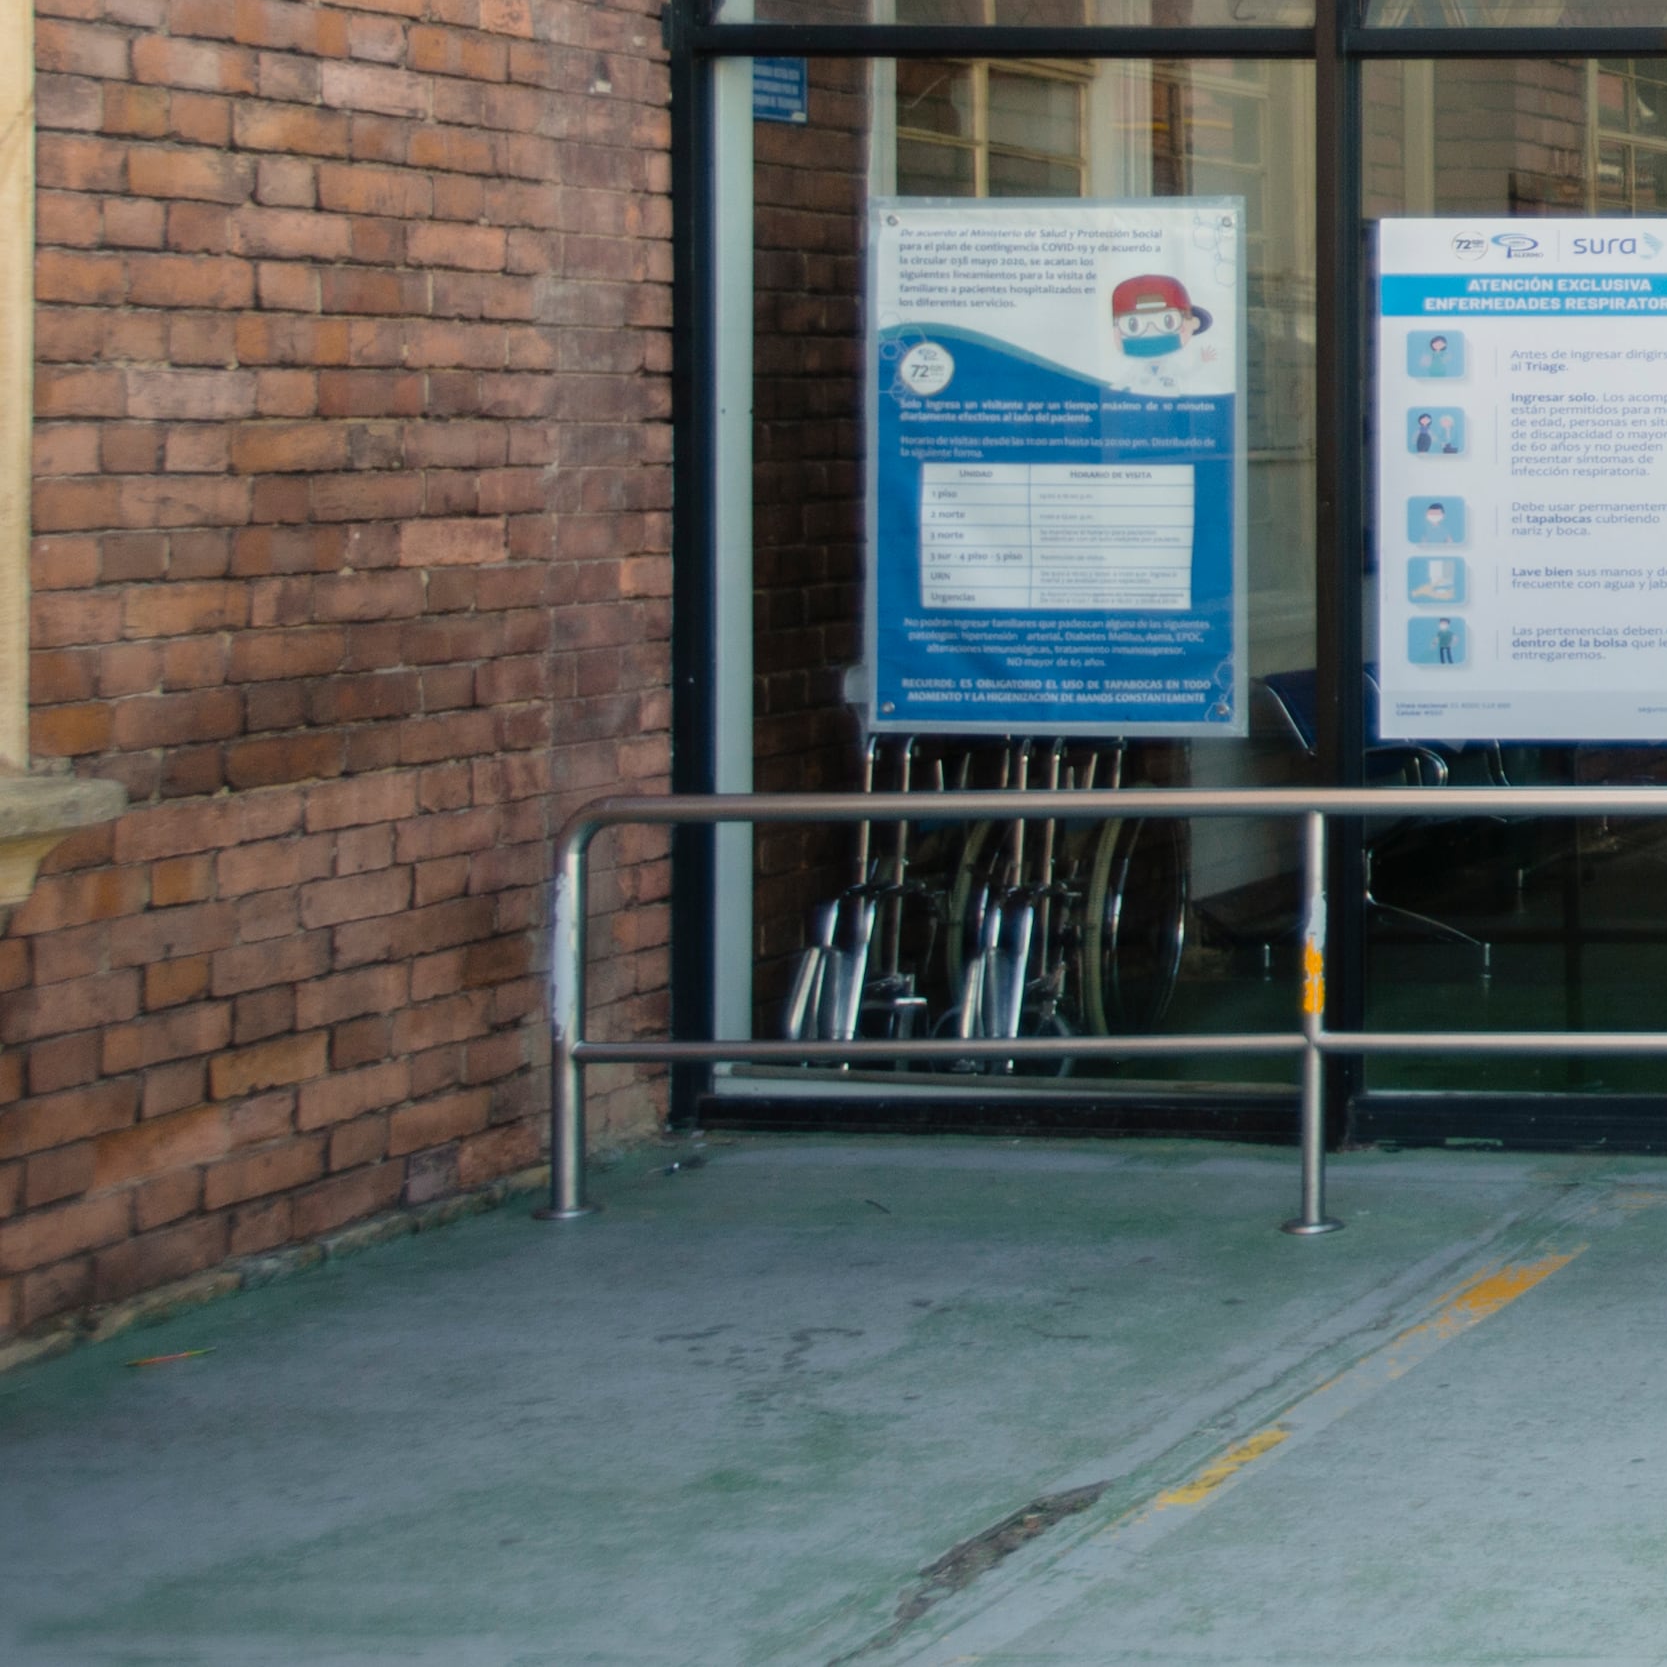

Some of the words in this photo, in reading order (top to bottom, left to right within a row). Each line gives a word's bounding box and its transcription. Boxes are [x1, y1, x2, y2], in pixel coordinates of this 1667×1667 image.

[1455, 238, 1472, 251] 72
[1573, 237, 1637, 255] sura
[1468, 277, 1554, 291] ATENCIÓN
[1557, 279, 1651, 291] EXCLUSIVA
[1424, 298, 1561, 310] ENFERMEDADES
[1509, 350, 1548, 359] Antes
[1550, 350, 1567, 359] de
[1570, 350, 1621, 362] ingresar
[910, 364, 930, 378] 72
[1511, 362, 1522, 371] al
[1526, 362, 1569, 374] Triage.
[1510, 393, 1564, 405] Ingresar
[1568, 393, 1600, 402] solo.
[1603, 393, 1624, 402] Los
[1510, 405, 1547, 414] están
[1548, 405, 1618, 417] permitidos
[1621, 407, 1650, 417] para
[1510, 417, 1527, 427] de
[1530, 417, 1566, 428] edad,
[1568, 419, 1628, 429] personas
[1630, 419, 1647, 427] en
[1510, 430, 1527, 439] de
[1529, 430, 1613, 442] discapacidad
[1510, 442, 1527, 452] de
[1529, 442, 1547, 452] 60
[1550, 442, 1581, 452] años
[1584, 444, 1591, 454] y
[1594, 444, 1611, 452] no
[1614, 442, 1663, 454] pueden
[1510, 454, 1572, 466] presentar
[1576, 454, 1634, 463] síntomas
[1637, 454, 1654, 463] de
[1510, 466, 1569, 476] infección
[1572, 467, 1650, 479] respiratoria.
[1511, 502, 1545, 512] Debe
[1548, 504, 1575, 512] usar
[938, 510, 965, 519] norte
[1511, 514, 1523, 523] el
[1526, 514, 1592, 526] tapabocas
[1595, 514, 1660, 523] cubriendo
[938, 531, 964, 539] norte
[1511, 526, 1543, 535] nariz
[1546, 528, 1553, 538] y
[1555, 526, 1591, 535] boca.
[1511, 567, 1542, 576] Lave
[1544, 567, 1573, 576] bien
[1646, 569, 1653, 579] y
[1512, 579, 1574, 588] frecuente
[1603, 581, 1635, 591] agua
[1638, 581, 1645, 591] y
[1512, 627, 1533, 636] Las
[1536, 627, 1619, 639] pertenencias
[1622, 627, 1663, 636] deben
[1512, 638, 1556, 647] dentro
[1559, 638, 1576, 647] de
[1578, 638, 1590, 647] la
[1592, 638, 1628, 647] bolsa
[1631, 640, 1655, 650] que
[1512, 650, 1606, 662] entregaremos.
